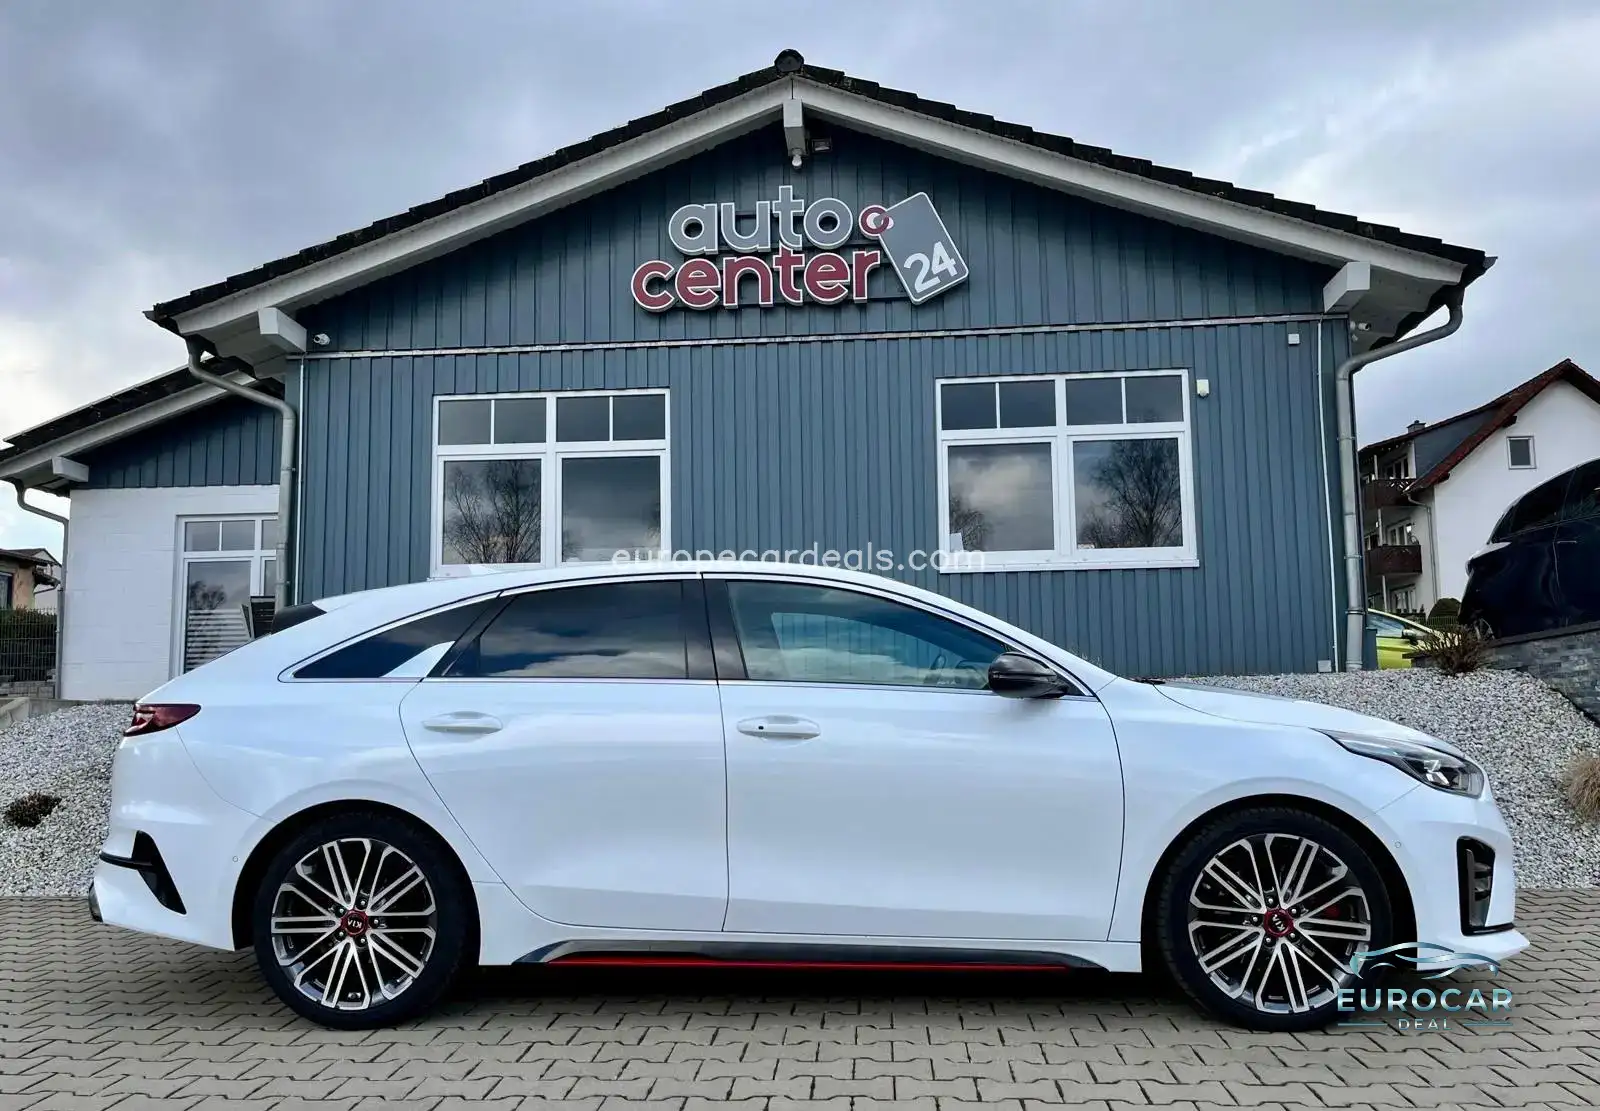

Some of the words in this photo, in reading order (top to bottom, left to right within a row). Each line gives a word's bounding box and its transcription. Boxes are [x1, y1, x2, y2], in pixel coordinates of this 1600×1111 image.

[668, 185, 853, 254] auto
[631, 240, 881, 313] center
[903, 241, 956, 293] 24
